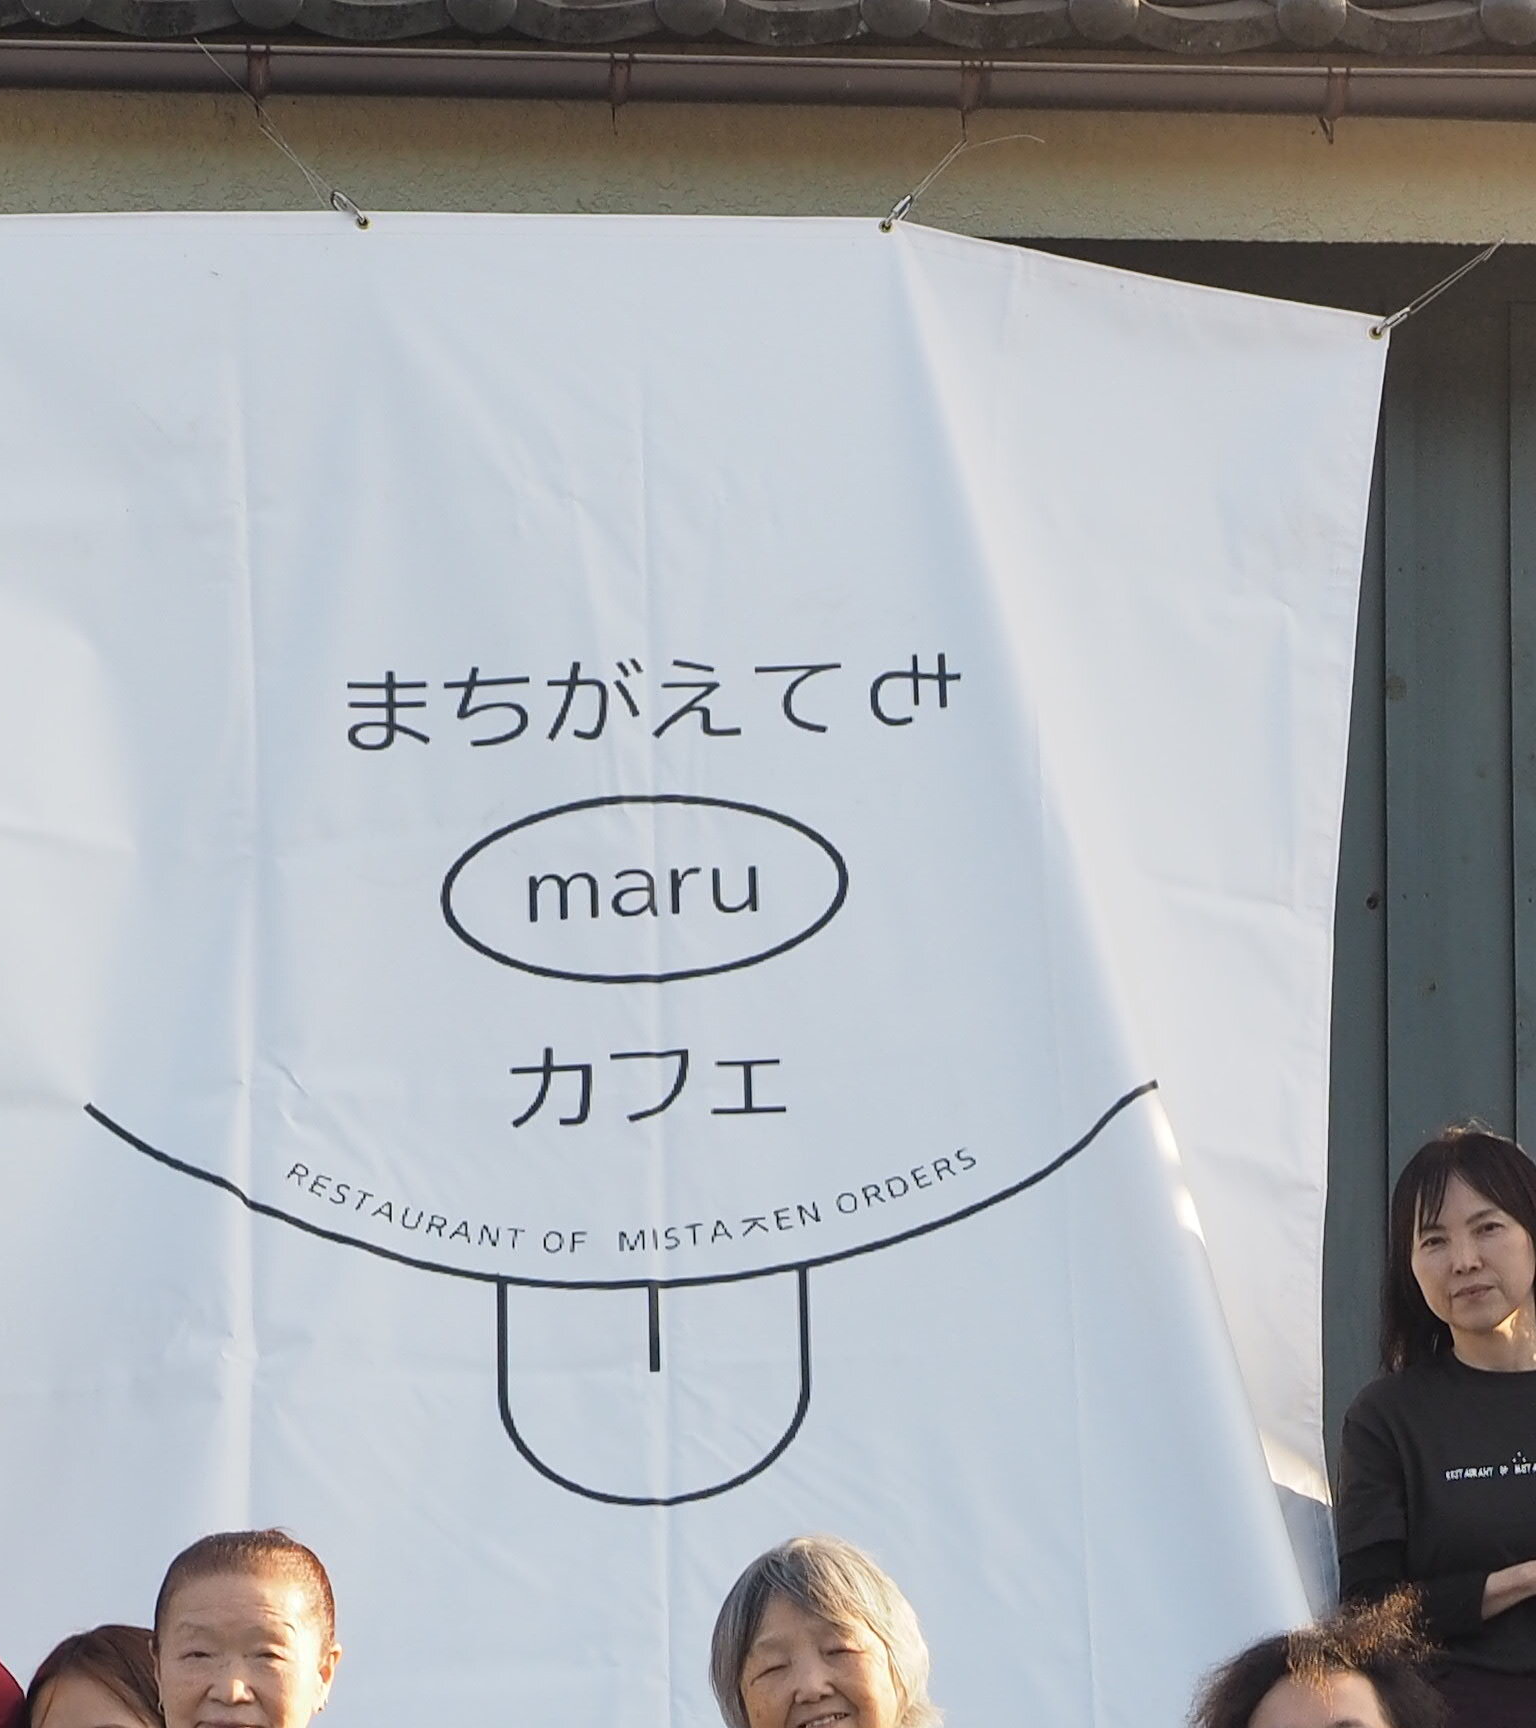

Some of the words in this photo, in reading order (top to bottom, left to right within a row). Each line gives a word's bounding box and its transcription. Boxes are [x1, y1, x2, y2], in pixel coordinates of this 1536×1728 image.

[528, 865, 759, 923] maru
[509, 1047, 787, 1128] カフェ
[287, 1163, 526, 1251] RESTAURANT
[543, 1231, 587, 1254] OF
[619, 1201, 822, 1253] MISTAKEN
[836, 1147, 977, 1214] ORDERS
